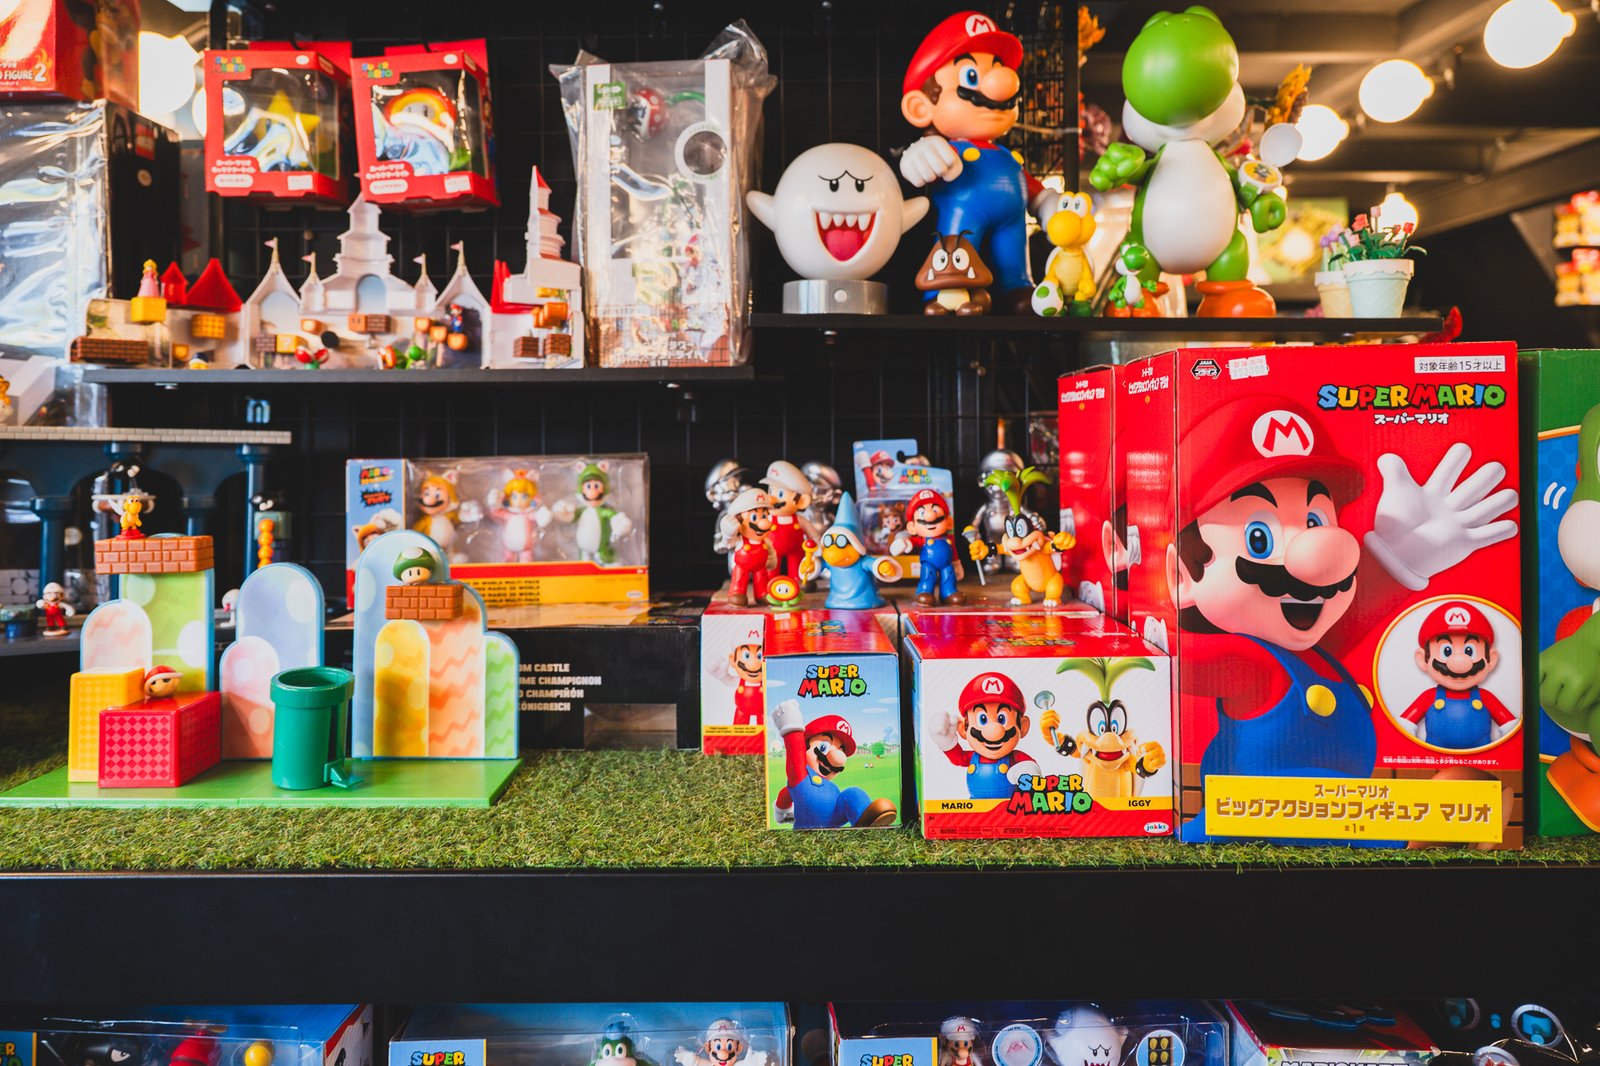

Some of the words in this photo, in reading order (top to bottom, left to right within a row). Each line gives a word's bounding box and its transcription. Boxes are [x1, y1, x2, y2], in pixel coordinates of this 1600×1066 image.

[4, 70, 33, 80] FIGURE
[34, 62, 47, 82] 2
[1317, 384, 1410, 410] SUPER
[1409, 383, 1507, 410] MARIO
[1374, 412, 1449, 425] スーパーマリオ
[534, 663, 570, 672] CASTLE
[806, 664, 860, 679] SUPER
[538, 676, 602, 685] CHAMPIGNON
[798, 678, 867, 698] MARIO
[526, 687, 584, 698] CHAMPIÑÓN
[519, 701, 571, 711] ÖNIGREICH
[1018, 773, 1084, 791] SUPER
[1314, 784, 1389, 799] スーパーマリオ
[941, 802, 974, 810] MARIO
[1008, 791, 1093, 815] MARIO
[1128, 799, 1152, 807] IGGY
[1216, 797, 1430, 821] ビッグアクションフィギュア
[1439, 803, 1492, 822] マリオ
[411, 1051, 465, 1066] SUPER
